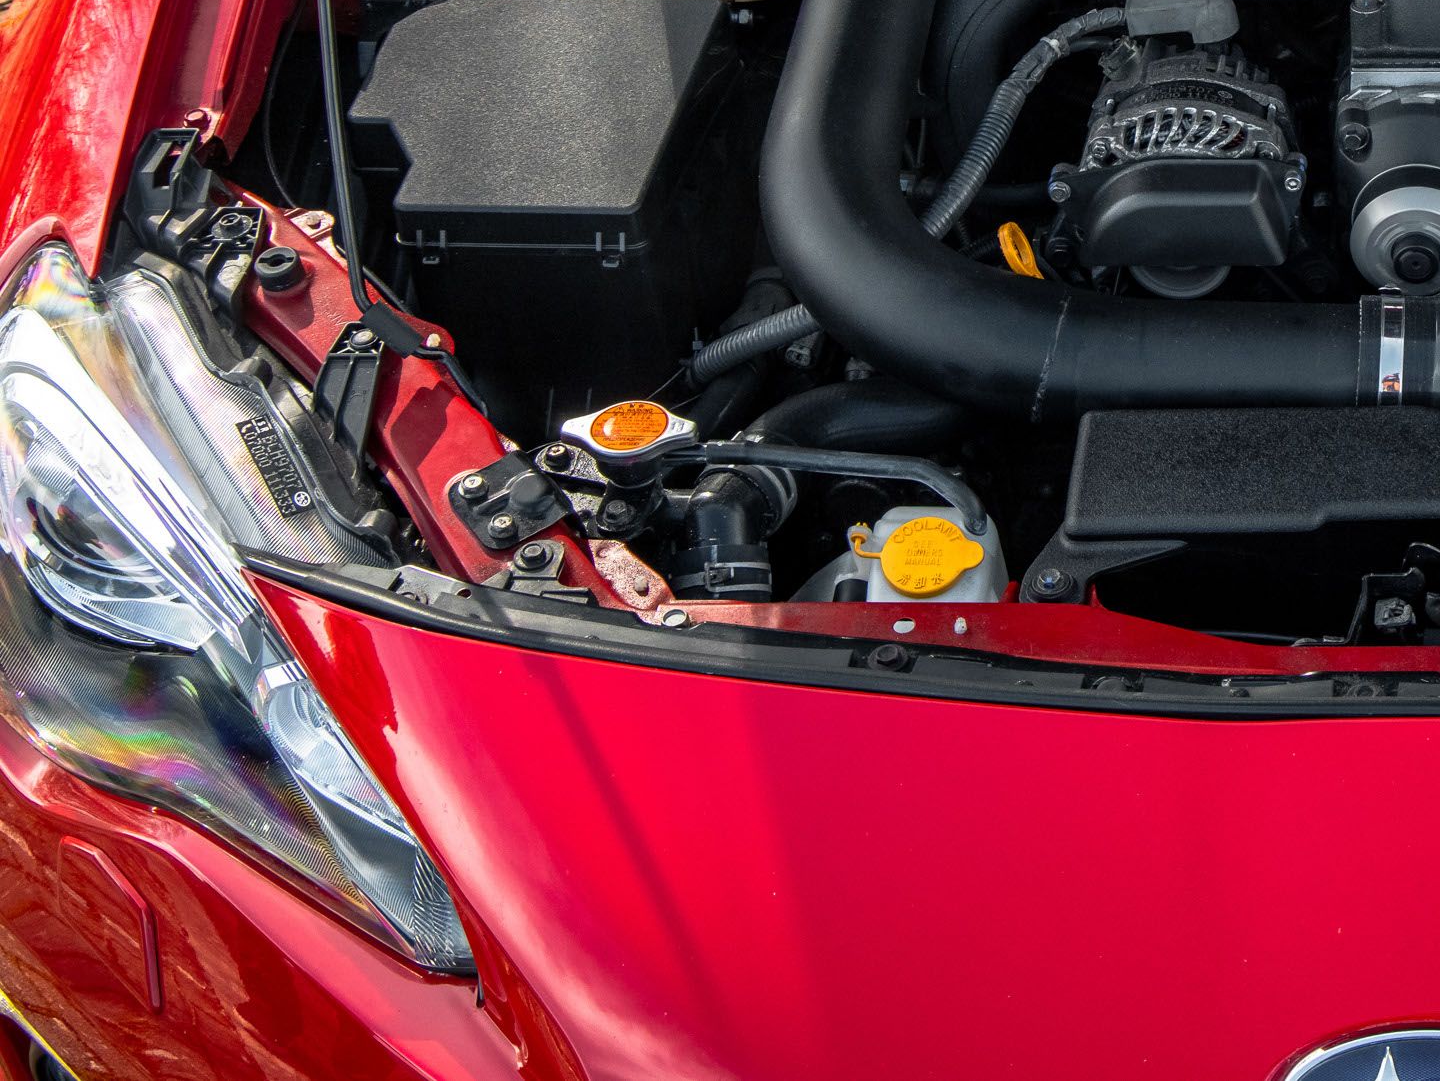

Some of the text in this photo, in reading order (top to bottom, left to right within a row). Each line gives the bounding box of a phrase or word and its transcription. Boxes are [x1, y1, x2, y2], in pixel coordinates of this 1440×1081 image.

[262, 434, 303, 488] BCH9707
[265, 471, 297, 514] 111333
[893, 519, 963, 544] COOLANT
[904, 557, 944, 566] MANUAL
